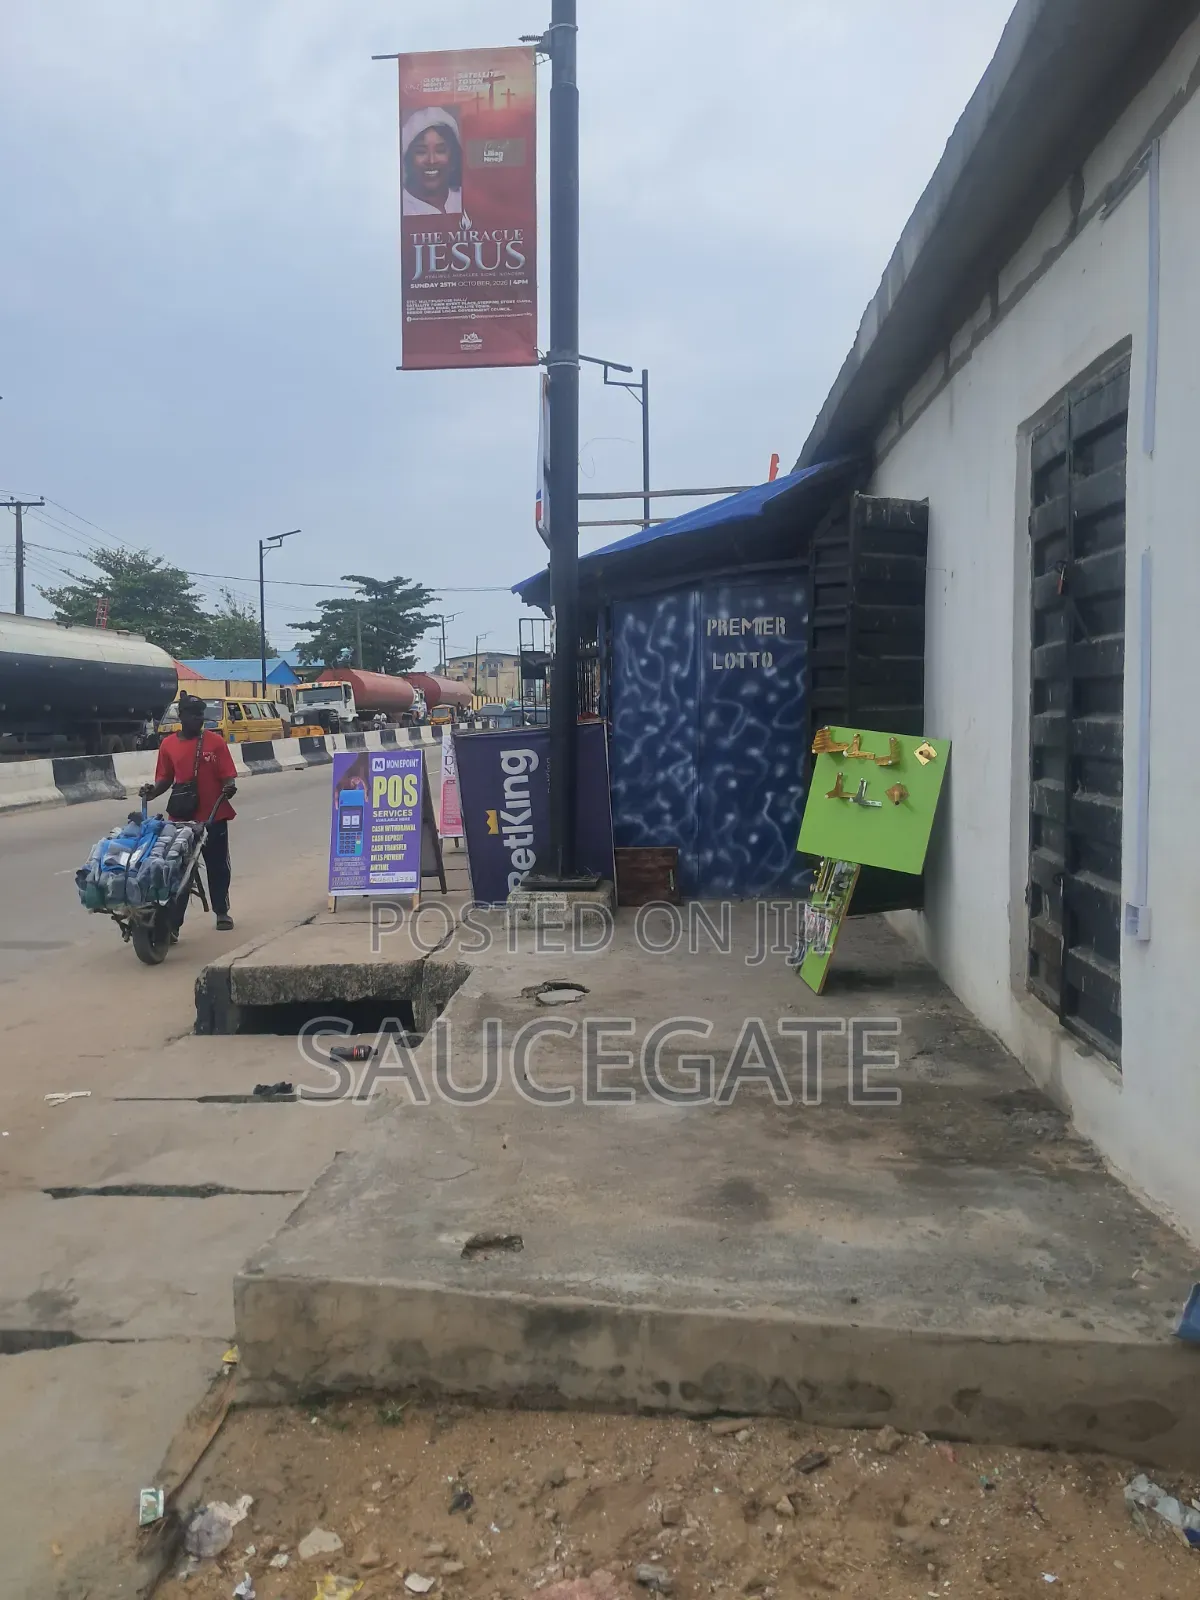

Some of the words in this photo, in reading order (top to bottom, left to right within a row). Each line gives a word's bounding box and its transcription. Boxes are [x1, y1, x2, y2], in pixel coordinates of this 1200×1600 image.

[410, 232, 442, 244] THE
[448, 228, 524, 242] MIRACLE
[412, 240, 526, 280] JESUS
[707, 616, 786, 636] PREMIER
[712, 652, 772, 670] LOTTO
[386, 758, 418, 768] MONIEPOINT
[372, 774, 418, 808] POS
[372, 810, 412, 818] SERVICES
[384, 824, 416, 832] WITHDRAWAL
[370, 864, 390, 872] AIRTIME
